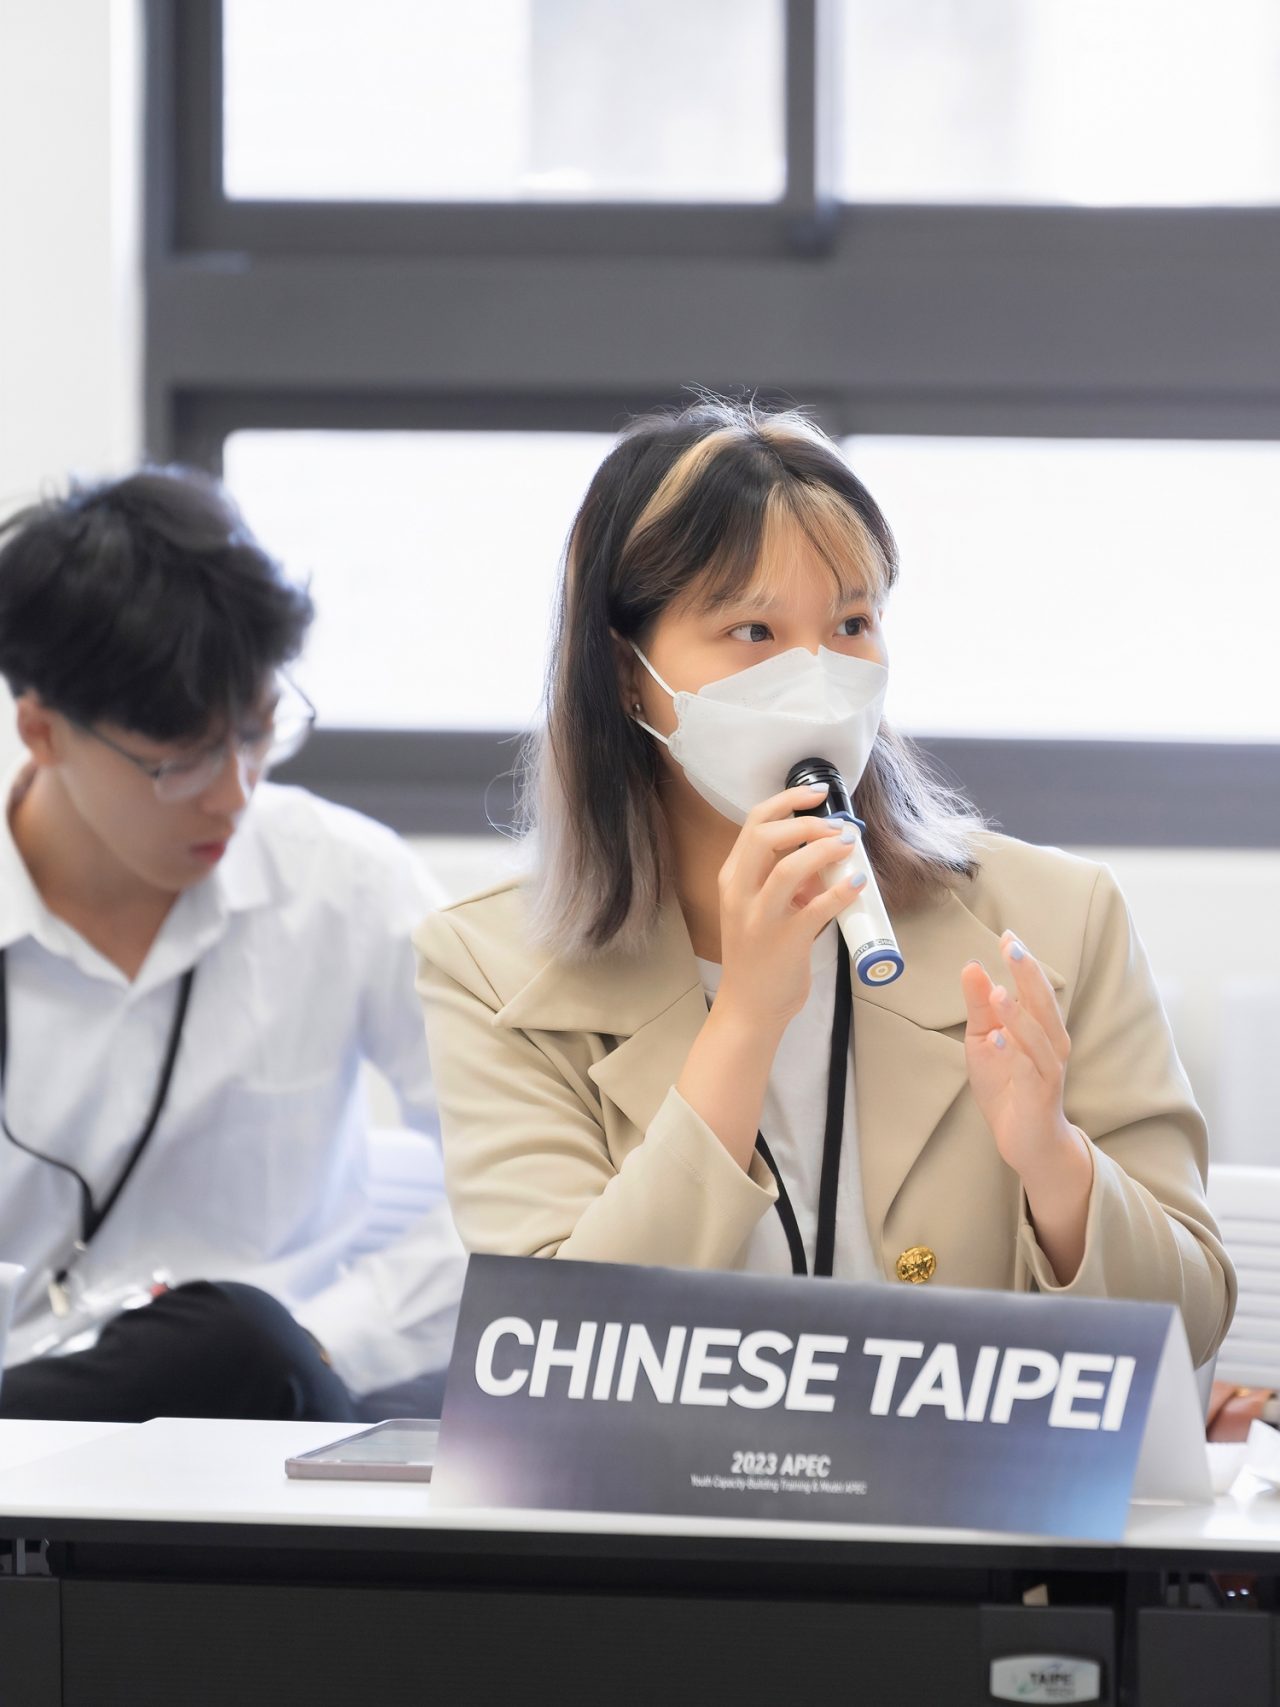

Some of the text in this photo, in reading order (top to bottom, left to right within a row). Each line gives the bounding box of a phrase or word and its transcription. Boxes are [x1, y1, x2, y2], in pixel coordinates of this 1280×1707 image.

[474, 1316, 1137, 1432] CHINESE TAIPEI
[730, 1450, 832, 1478] 2023 APEC
